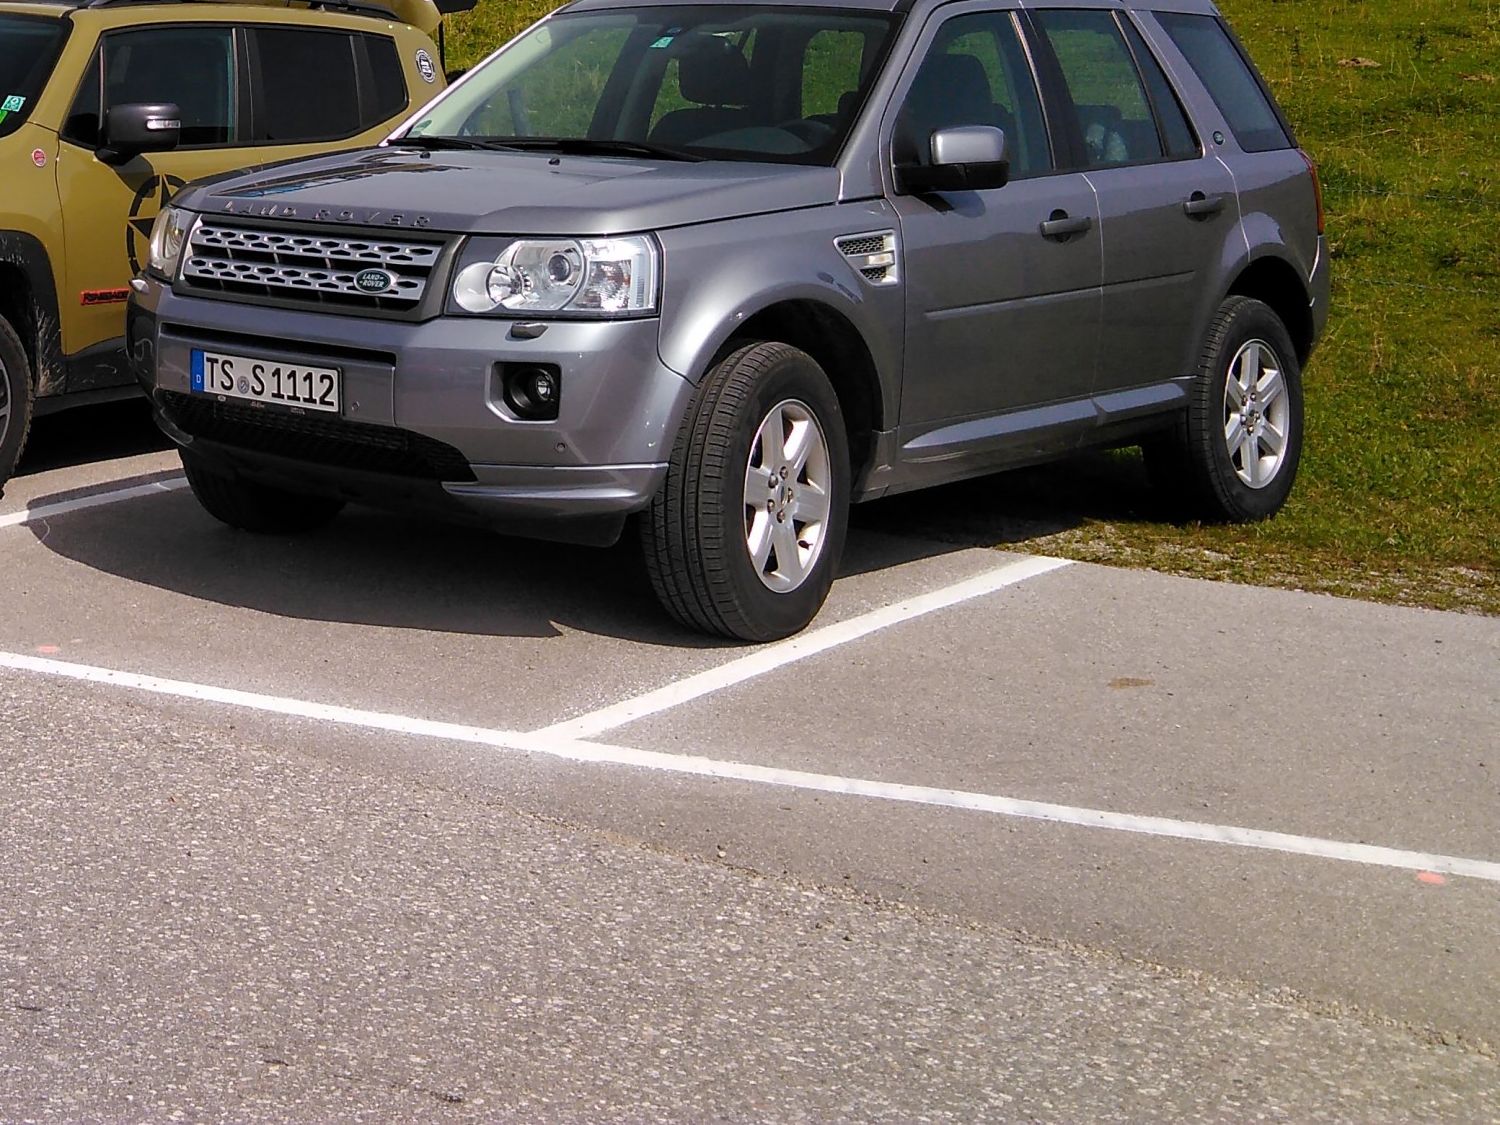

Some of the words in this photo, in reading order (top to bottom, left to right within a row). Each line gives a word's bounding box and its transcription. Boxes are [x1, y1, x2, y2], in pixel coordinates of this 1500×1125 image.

[221, 201, 297, 217] LAND
[312, 209, 430, 227] ROVER
[361, 279, 385, 288] ROVER
[206, 356, 235, 392] TS
[251, 364, 266, 396] S
[271, 367, 335, 407] 1112
